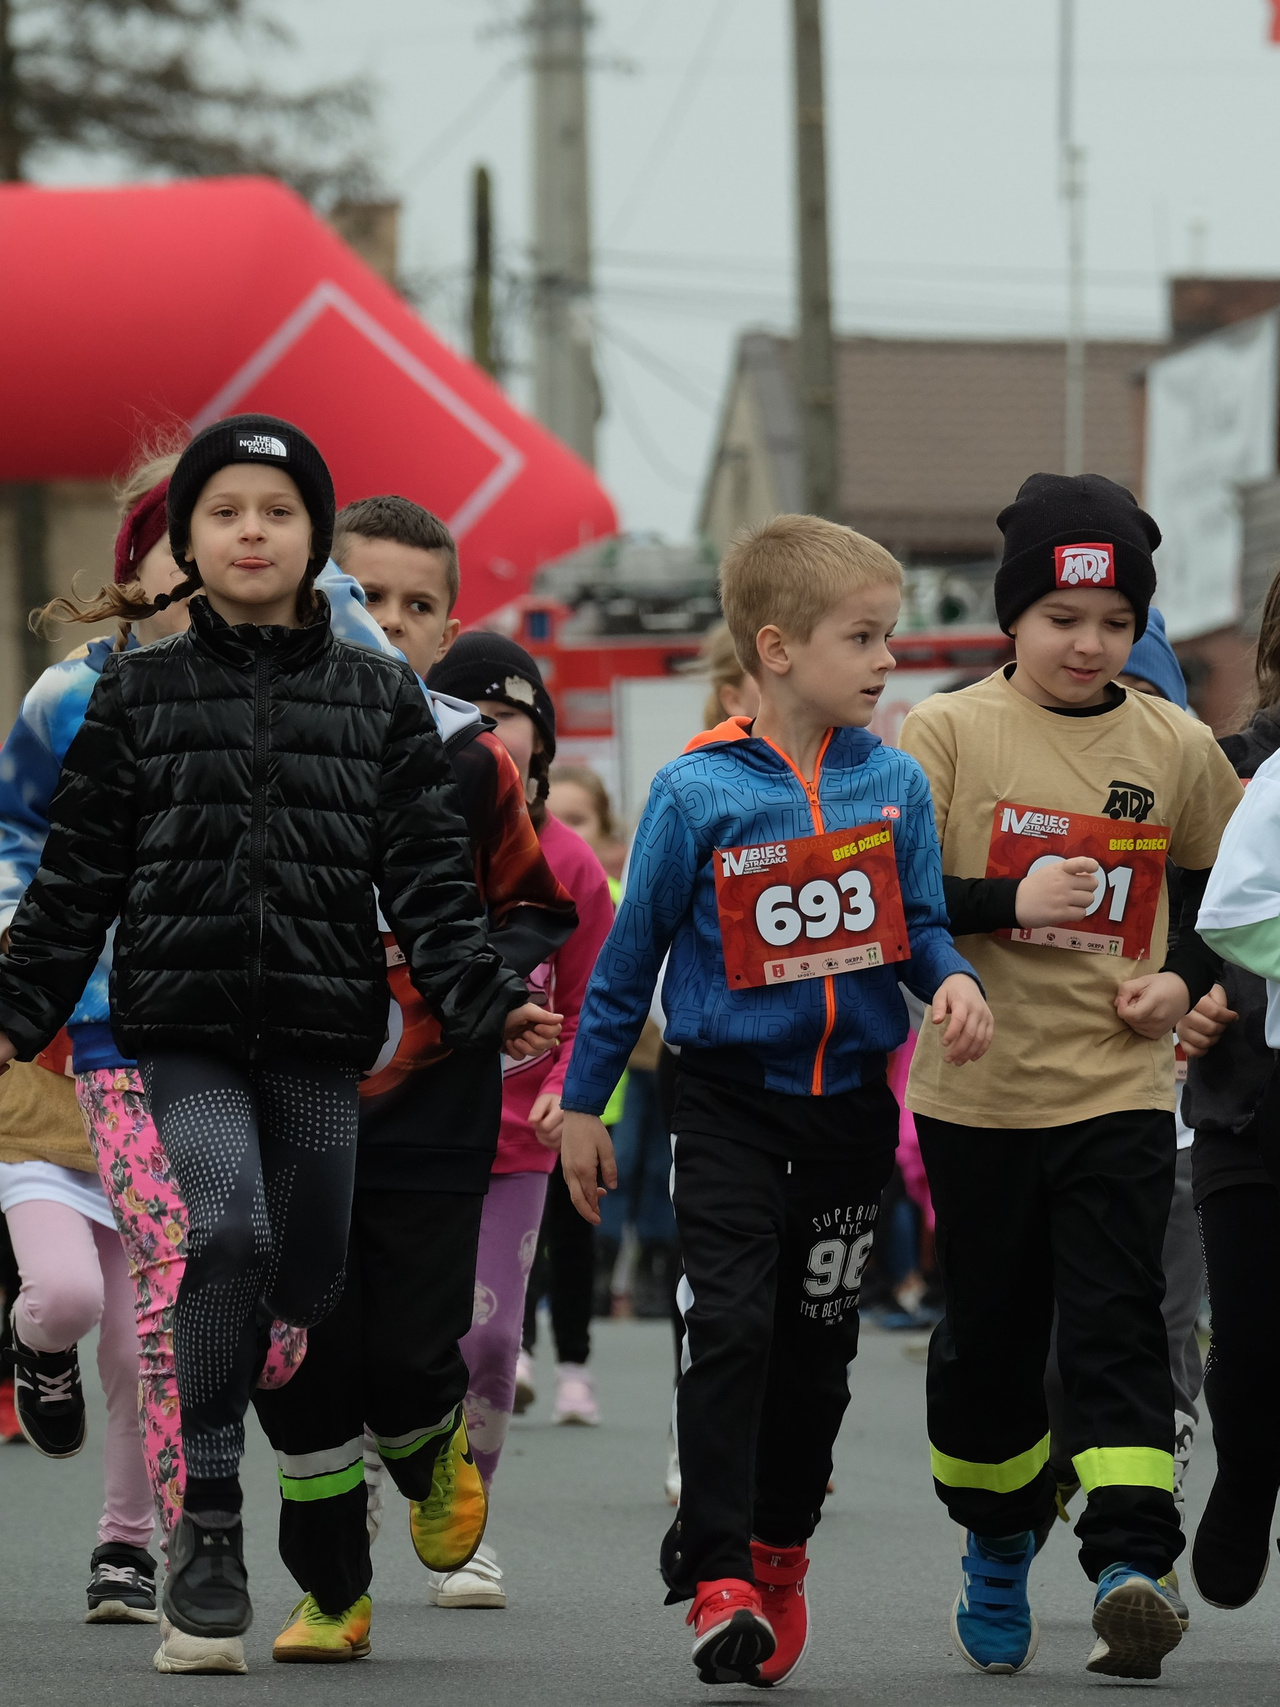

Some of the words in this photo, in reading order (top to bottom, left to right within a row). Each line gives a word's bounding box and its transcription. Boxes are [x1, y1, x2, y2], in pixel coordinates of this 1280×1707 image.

[239, 440, 271, 448] NORTH
[253, 435, 271, 443] THE
[248, 446, 271, 455] FACE
[1060, 548, 1110, 585] MDP
[1101, 780, 1155, 823] MDP
[1001, 807, 1034, 835] IV
[1030, 812, 1070, 830] BIEG
[1025, 823, 1068, 836] STRAŻAKA
[832, 840, 858, 862] BIEG
[858, 830, 891, 851] DZIECI
[1109, 838, 1135, 851] BIEG
[1136, 837, 1168, 851] DZIECI
[722, 849, 749, 878] IV
[747, 844, 787, 861] BIEG
[744, 856, 788, 868] STRAŻAKA
[755, 870, 876, 946] 693
[800, 1299, 819, 1319] THE
[822, 1298, 842, 1318] BEST
